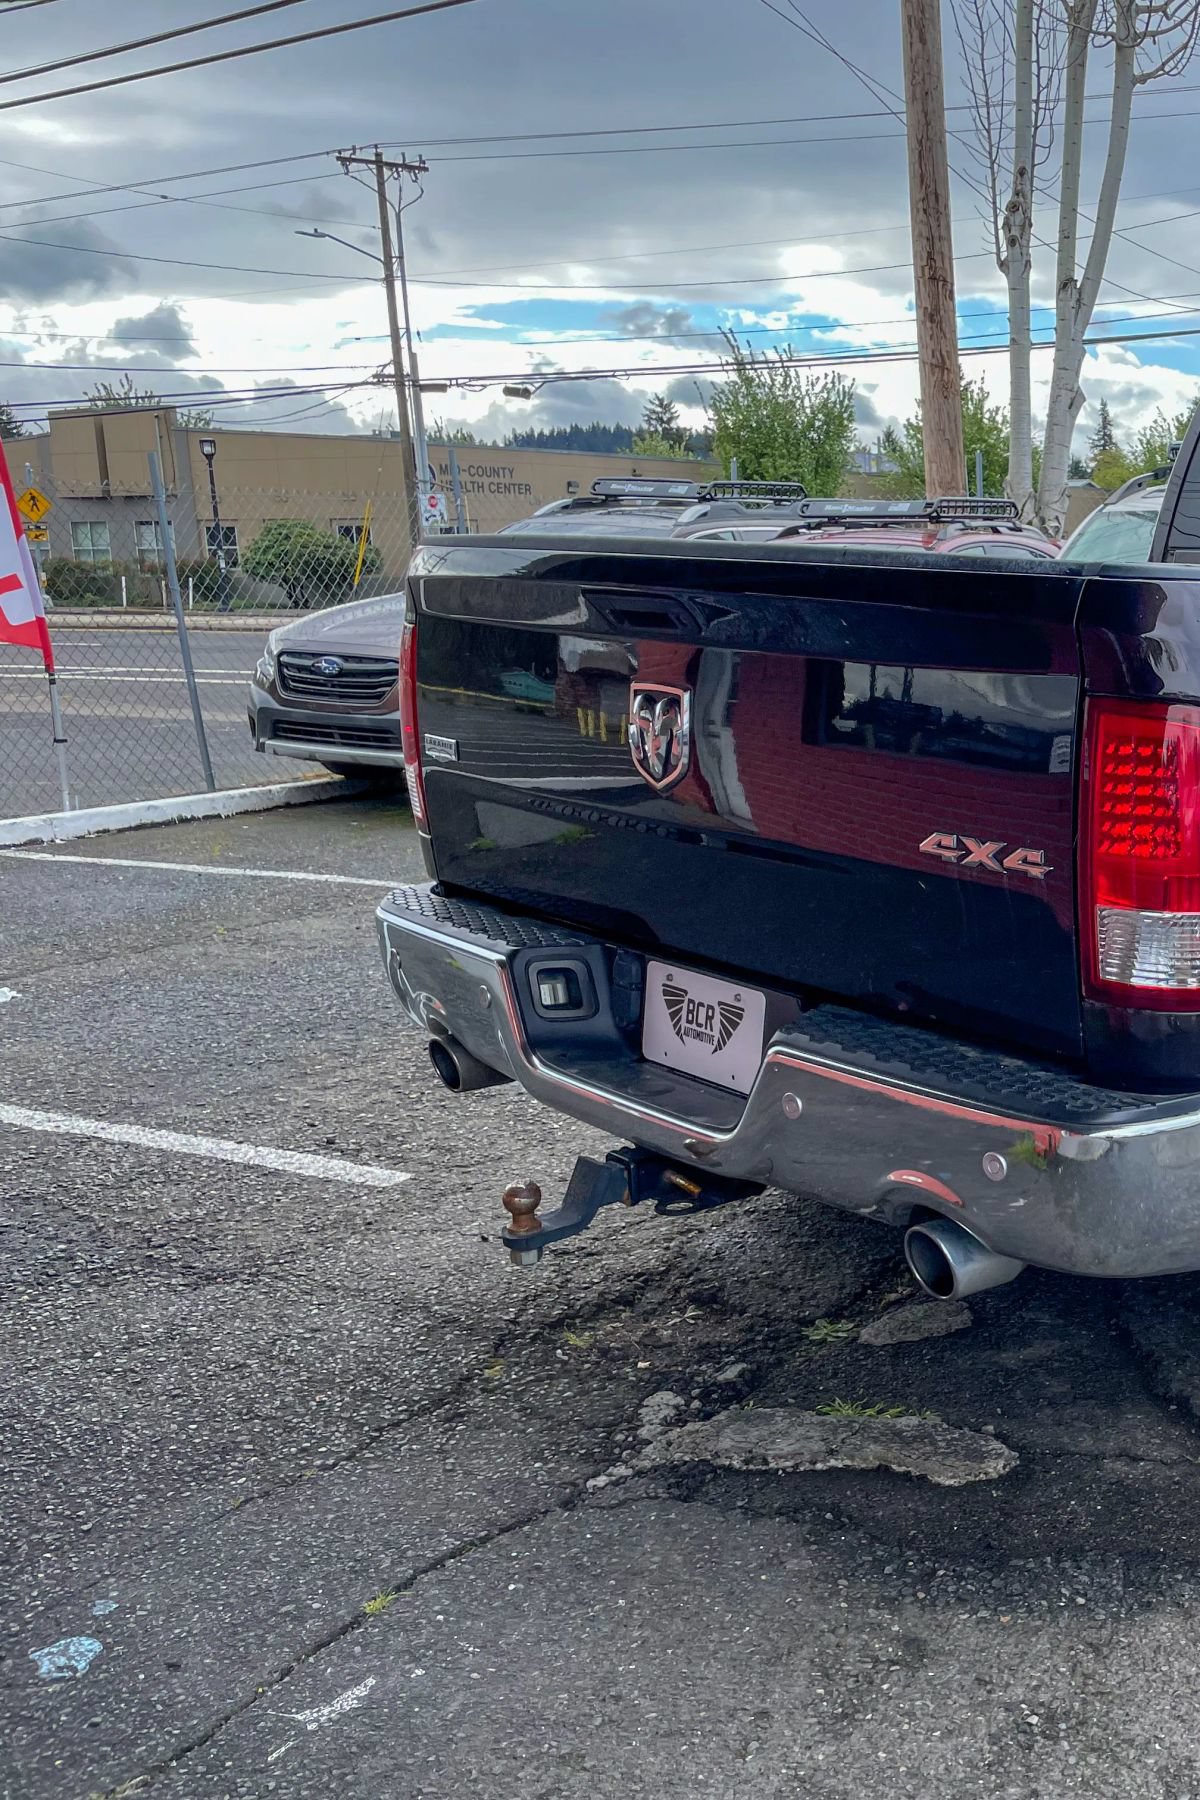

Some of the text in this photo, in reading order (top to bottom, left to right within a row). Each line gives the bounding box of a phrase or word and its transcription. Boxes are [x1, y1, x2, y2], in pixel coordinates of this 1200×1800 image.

[488, 481, 532, 496] CENTER
[685, 997, 716, 1033] BCR
[683, 1026, 716, 1046] AUTOMOTIVE
